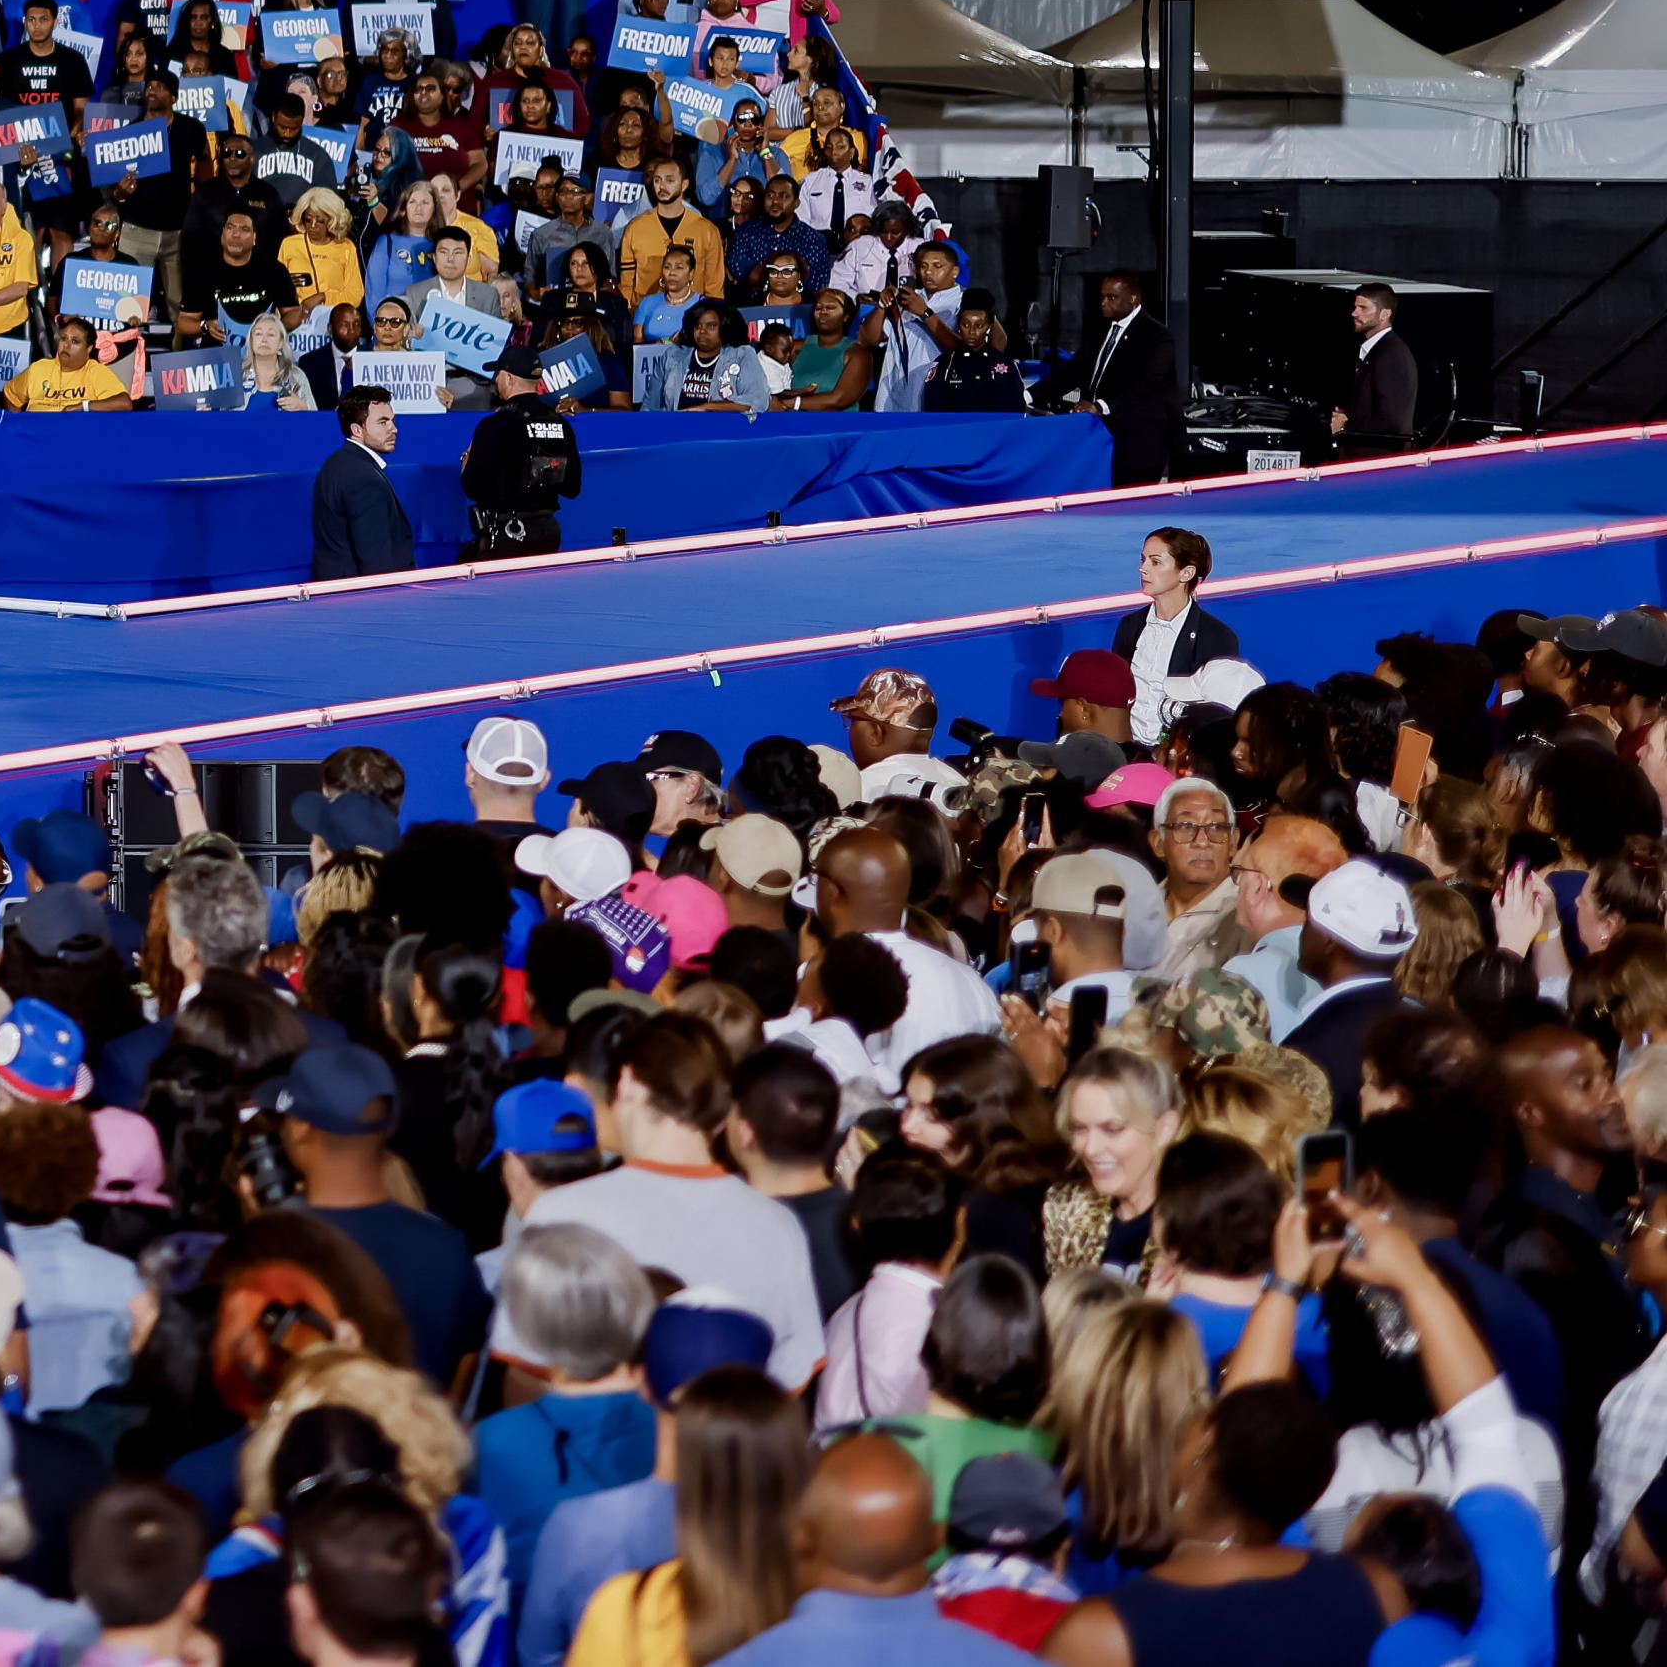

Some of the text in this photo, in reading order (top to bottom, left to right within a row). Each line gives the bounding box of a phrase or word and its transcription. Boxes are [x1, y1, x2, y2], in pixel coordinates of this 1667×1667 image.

[273, 17, 330, 38] GEORGIA
[361, 14, 425, 31] A NEW WAY
[619, 27, 689, 57] FREEDOM
[21, 65, 57, 78] WHEN
[30, 78, 48, 90] WE
[18, 92, 60, 104] VOTE
[668, 83, 723, 116] GEORGIA
[95, 133, 164, 165] FREEDOM
[505, 145, 543, 164] A NEW
[258, 153, 314, 183] HOWARD
[76, 270, 138, 294] GEORGIA
[430, 313, 495, 351] vote
[163, 363, 234, 395] KAMALA
[361, 364, 436, 383] A NEW WAY
[45, 387, 85, 400] UFCW
